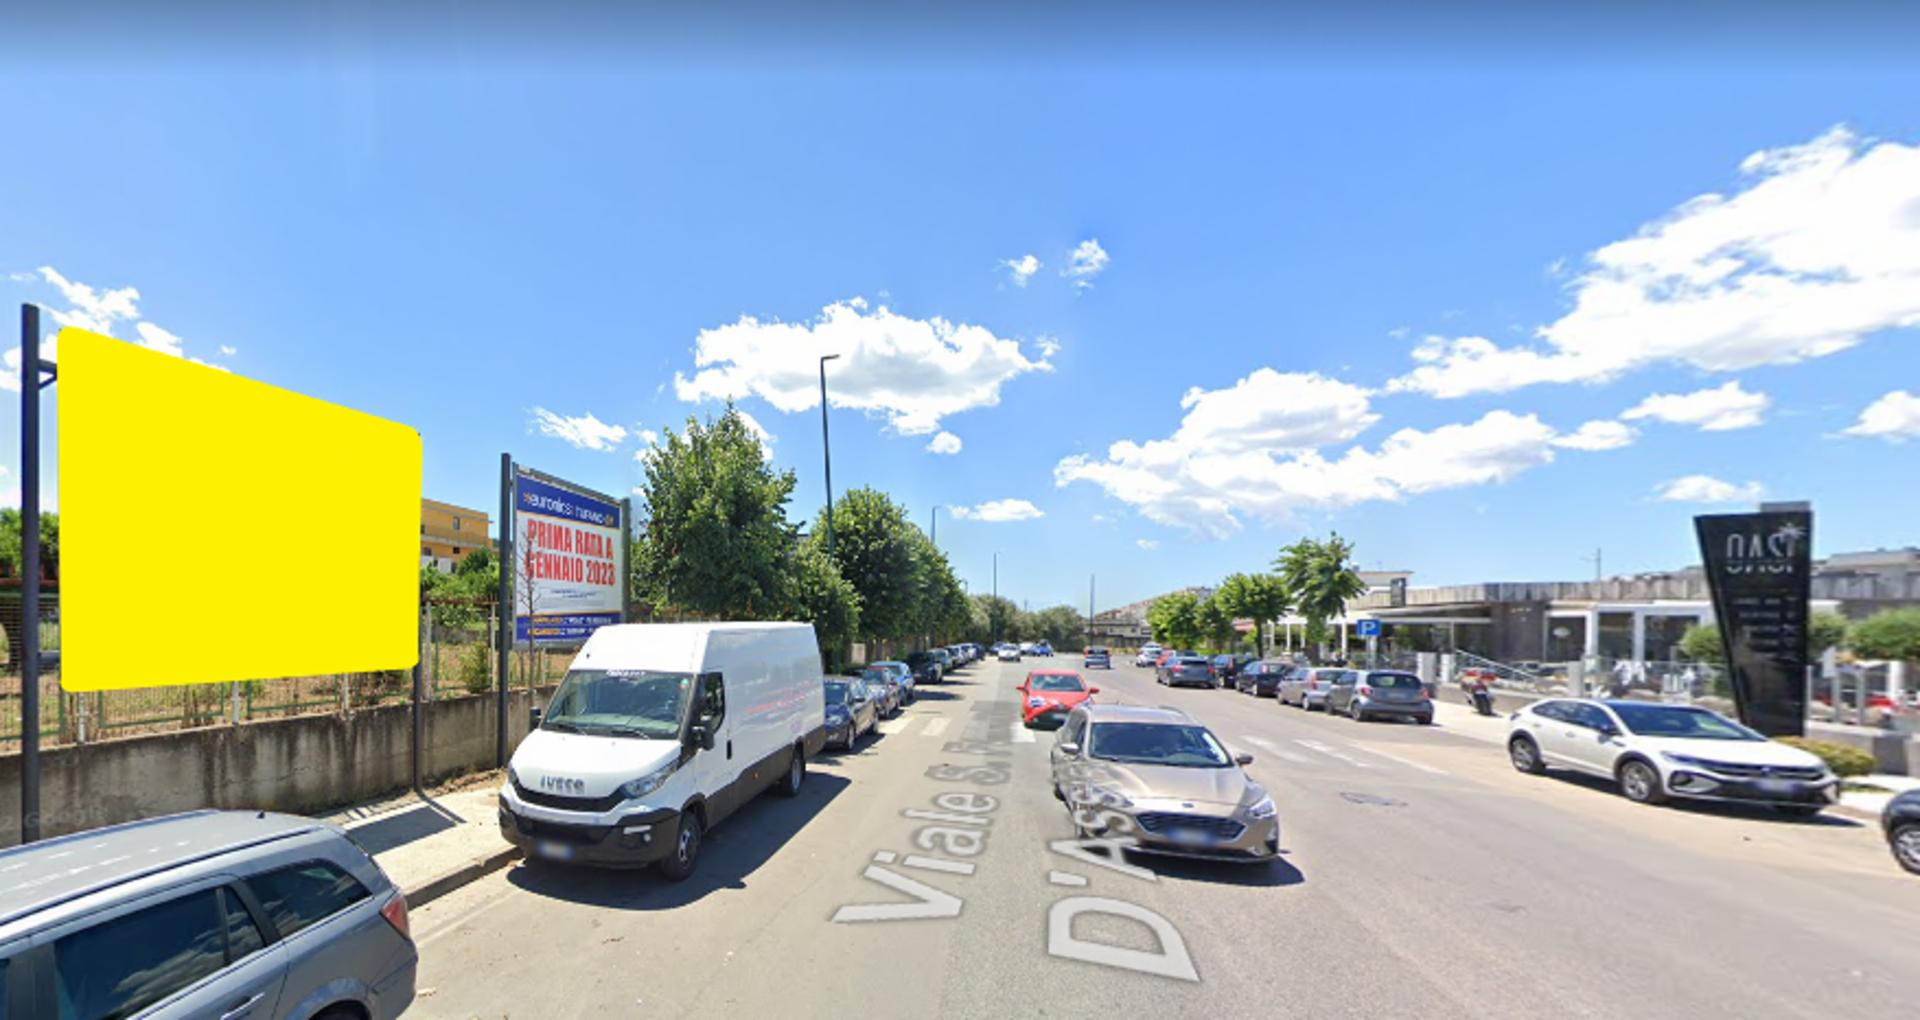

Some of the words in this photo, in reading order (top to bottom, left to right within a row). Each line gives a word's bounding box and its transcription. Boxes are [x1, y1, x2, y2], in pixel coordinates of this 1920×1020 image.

[527, 519, 571, 552] PRIMA
[575, 529, 603, 557] RATA
[606, 537, 613, 560] A
[525, 551, 583, 582] GENNAIO
[586, 560, 615, 586] 2023
[1361, 621, 1376, 635] P
[540, 775, 585, 796] IVECO
